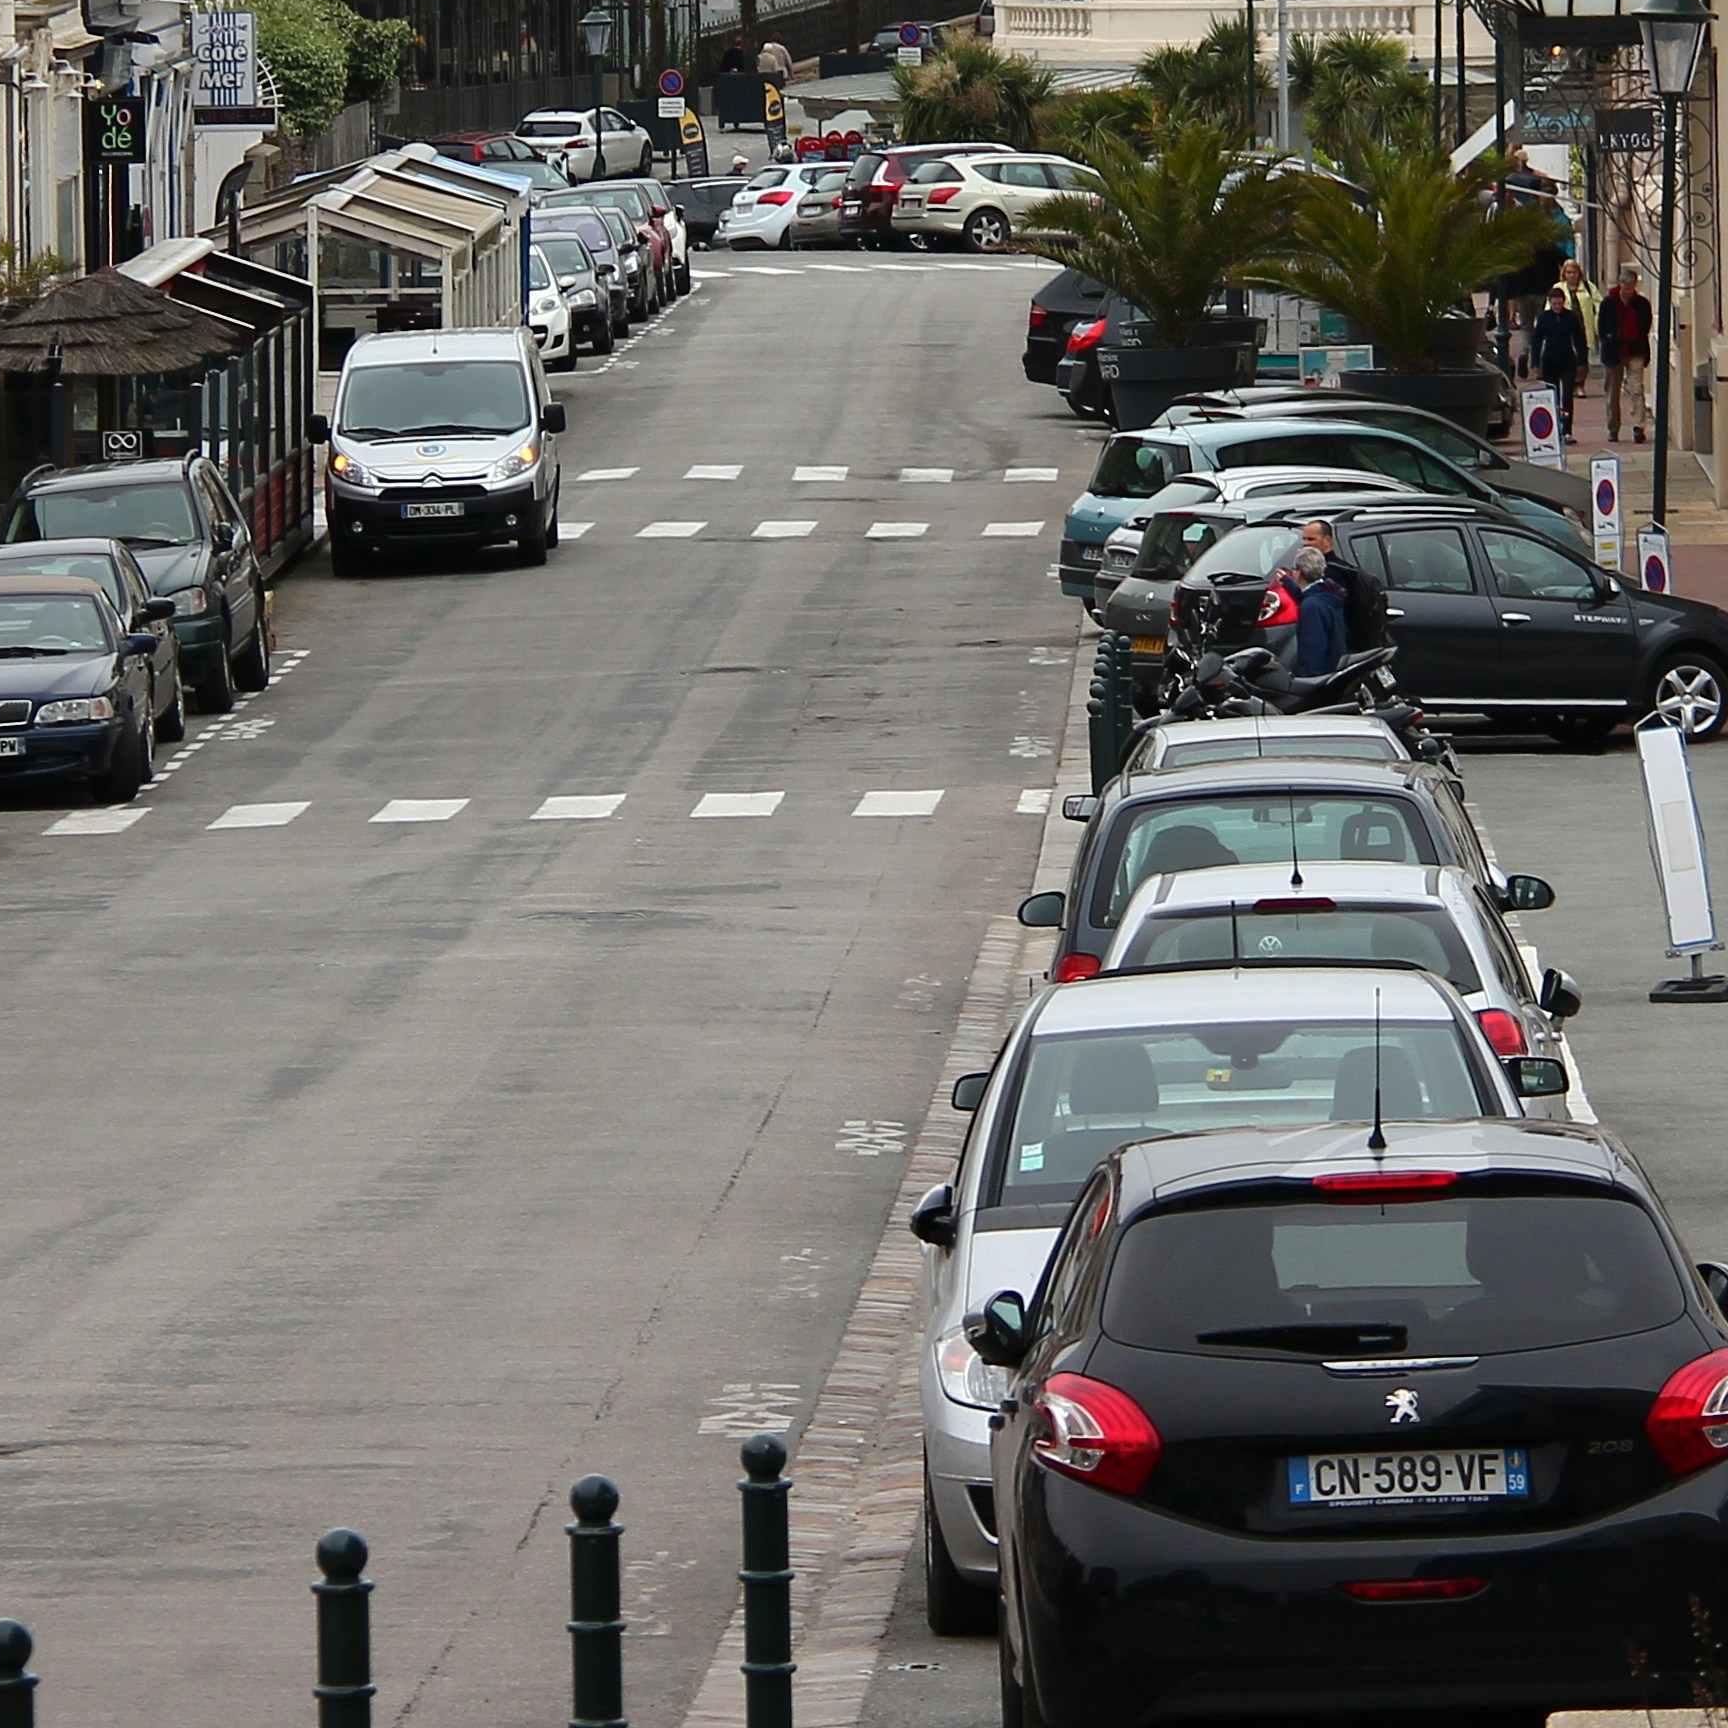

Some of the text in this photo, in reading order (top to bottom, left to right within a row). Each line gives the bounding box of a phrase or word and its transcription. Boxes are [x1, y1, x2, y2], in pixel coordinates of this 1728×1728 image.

[197, 39, 249, 62] Côté
[200, 71, 245, 89] Mer
[1314, 1453, 1499, 1496] CN-589-VF
[1509, 1474, 1525, 1490] 59
[1295, 1484, 1304, 1495] F
